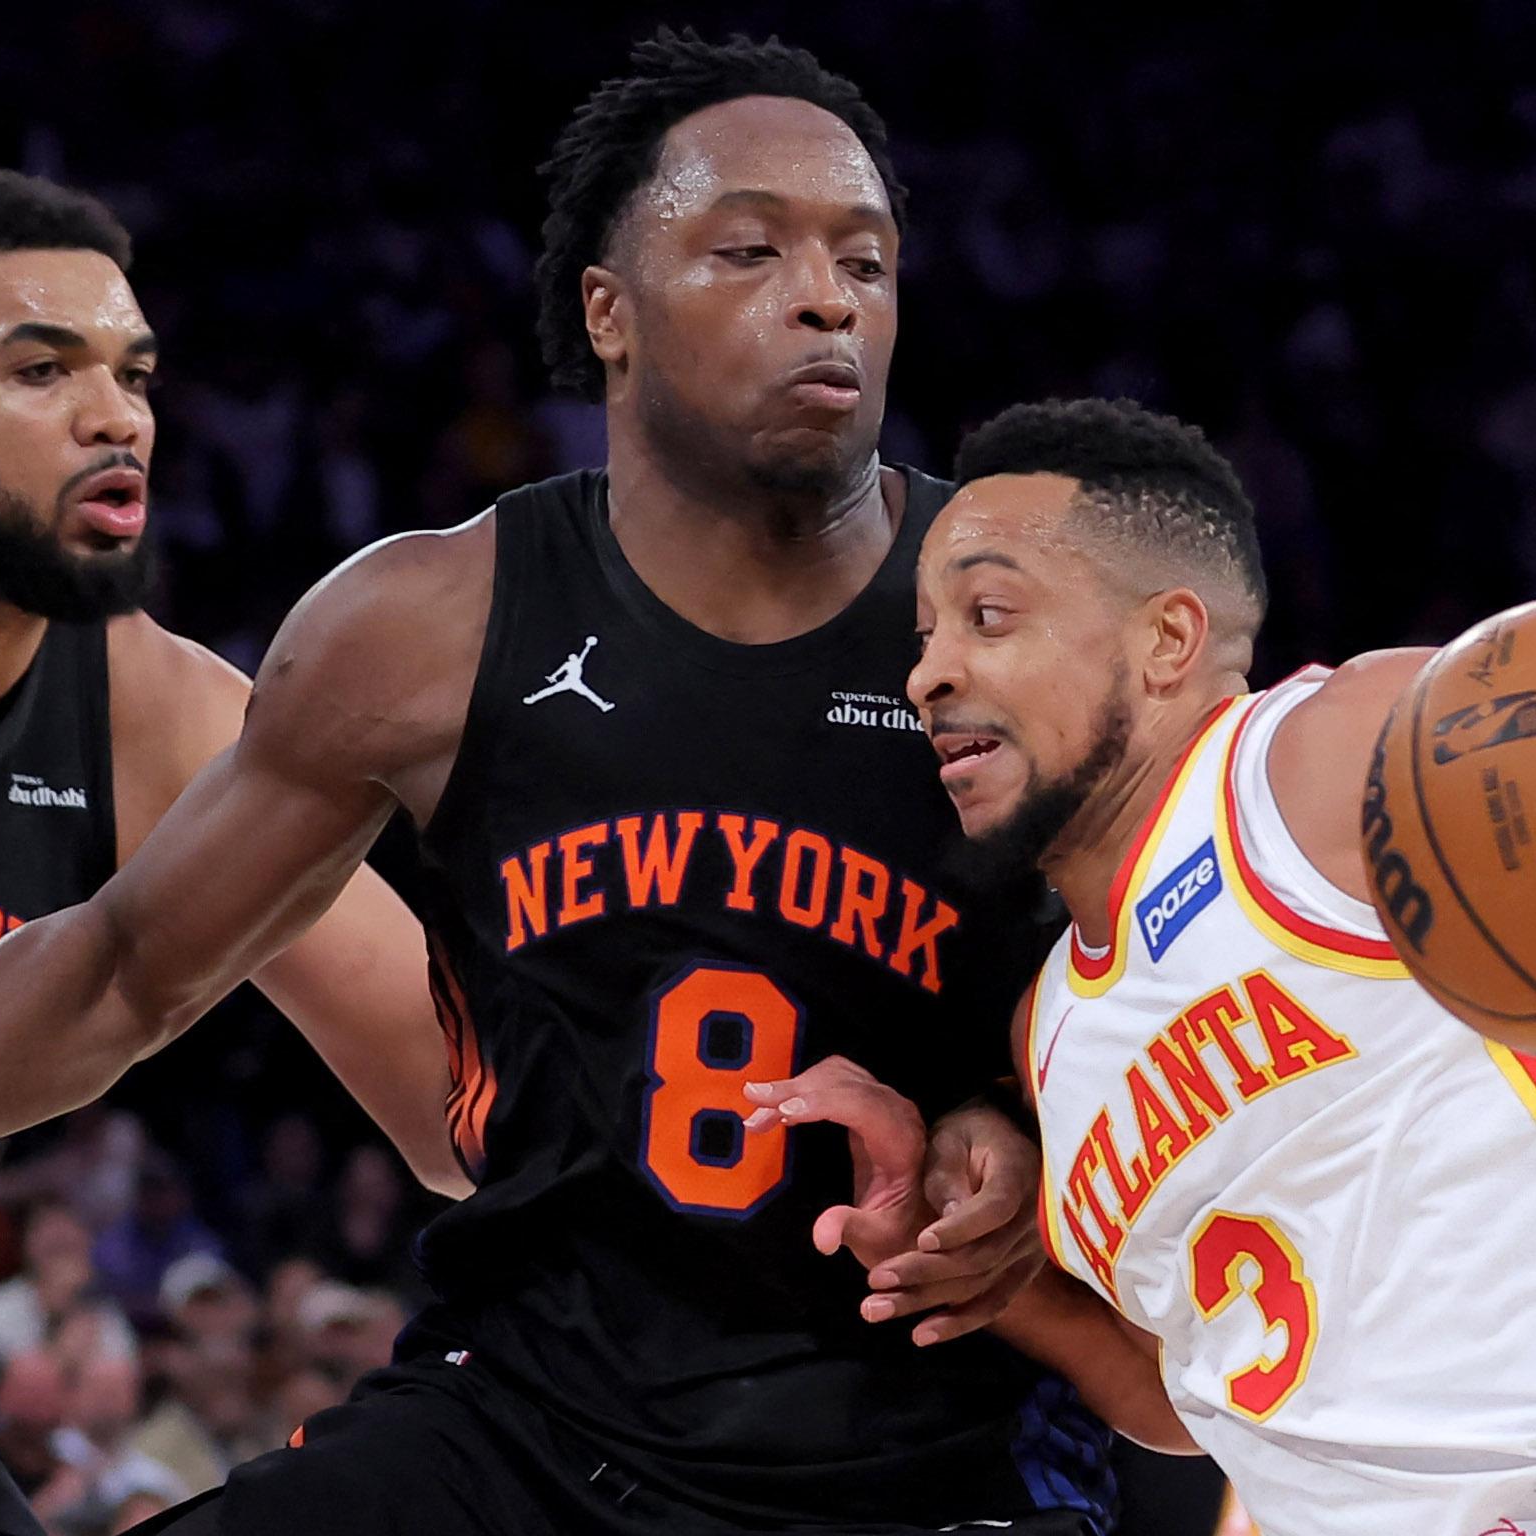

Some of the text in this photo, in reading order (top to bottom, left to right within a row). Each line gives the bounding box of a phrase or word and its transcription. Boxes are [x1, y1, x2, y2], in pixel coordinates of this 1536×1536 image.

[826, 703, 878, 727] abu
[831, 691, 901, 706] experience
[499, 810, 961, 996] NEW YORK
[1144, 856, 1215, 950] paze
[638, 957, 807, 1222] 8
[1061, 967, 1360, 1312] ATLANTA
[1188, 1208, 1319, 1424] 3
